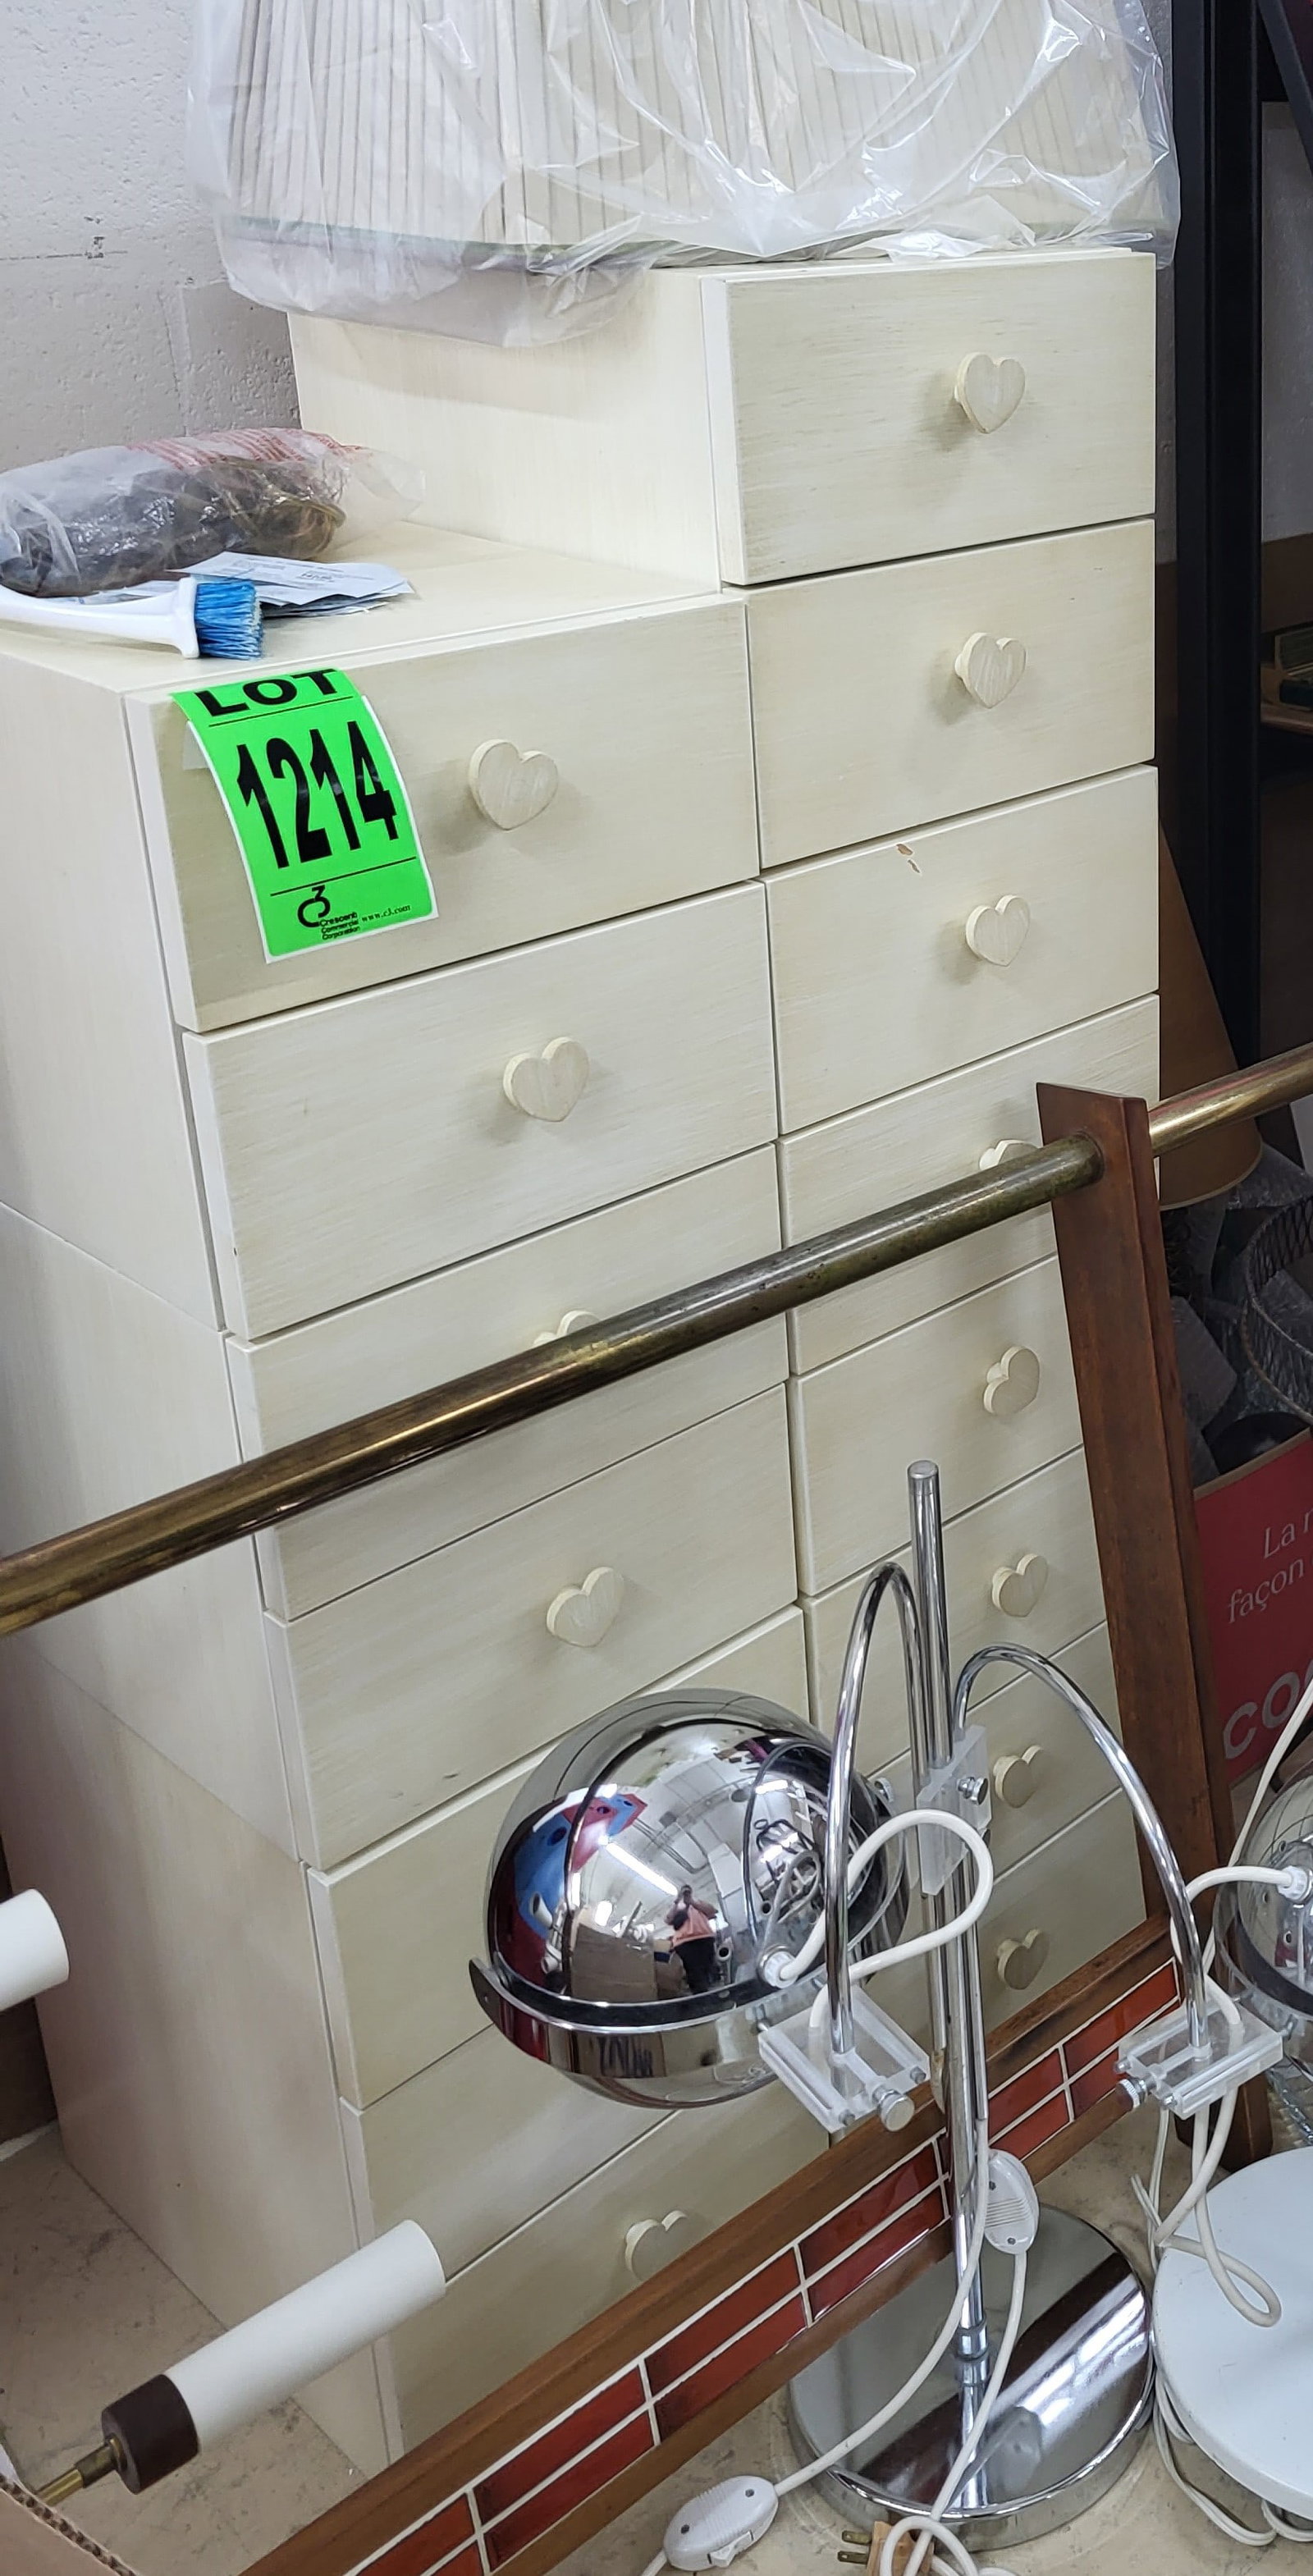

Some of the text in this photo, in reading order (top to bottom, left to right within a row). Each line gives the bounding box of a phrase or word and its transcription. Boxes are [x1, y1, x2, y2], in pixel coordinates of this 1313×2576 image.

[194, 668, 337, 717] LOT
[236, 721, 397, 869] 1214
[319, 911, 358, 928] Crescent
[1263, 1523, 1296, 1559] La
[1228, 1558, 1304, 1624] façon
[1224, 1659, 1313, 1759] CO
